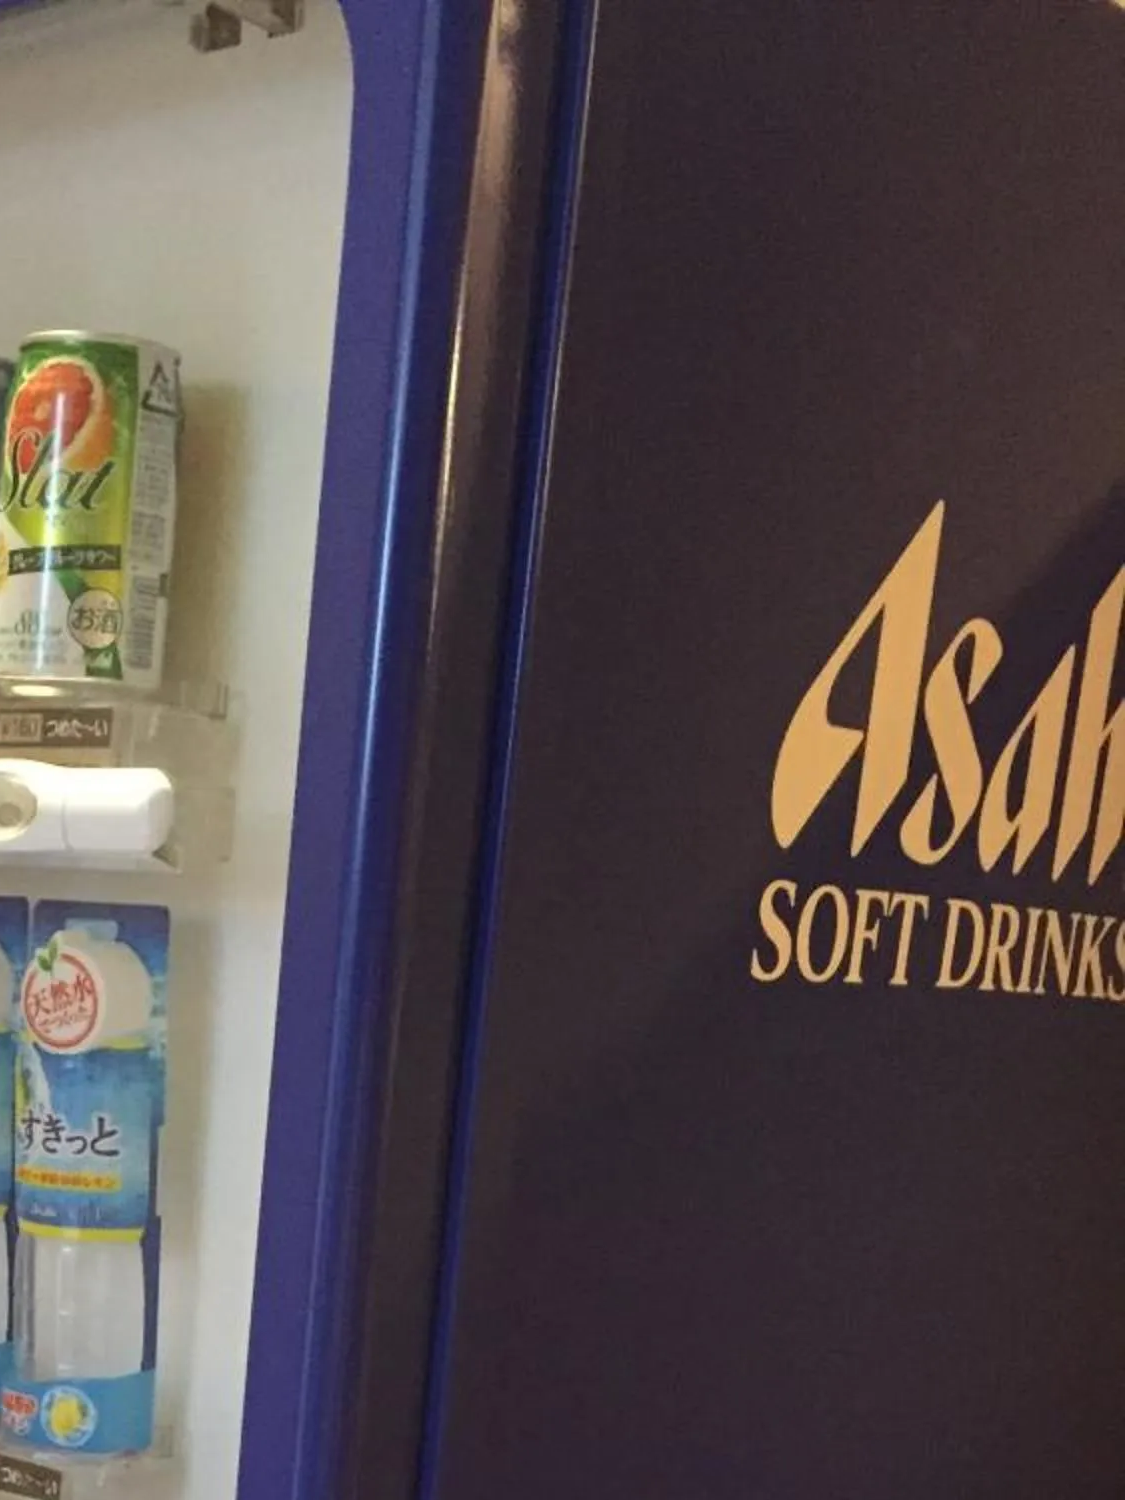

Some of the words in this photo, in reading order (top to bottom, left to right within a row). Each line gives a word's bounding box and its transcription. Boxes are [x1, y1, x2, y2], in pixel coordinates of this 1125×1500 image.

[71, 607, 118, 634] お酒
[771, 498, 1125, 887] Asah
[750, 878, 930, 987] SOFT
[21, 1110, 120, 1157] すきっと
